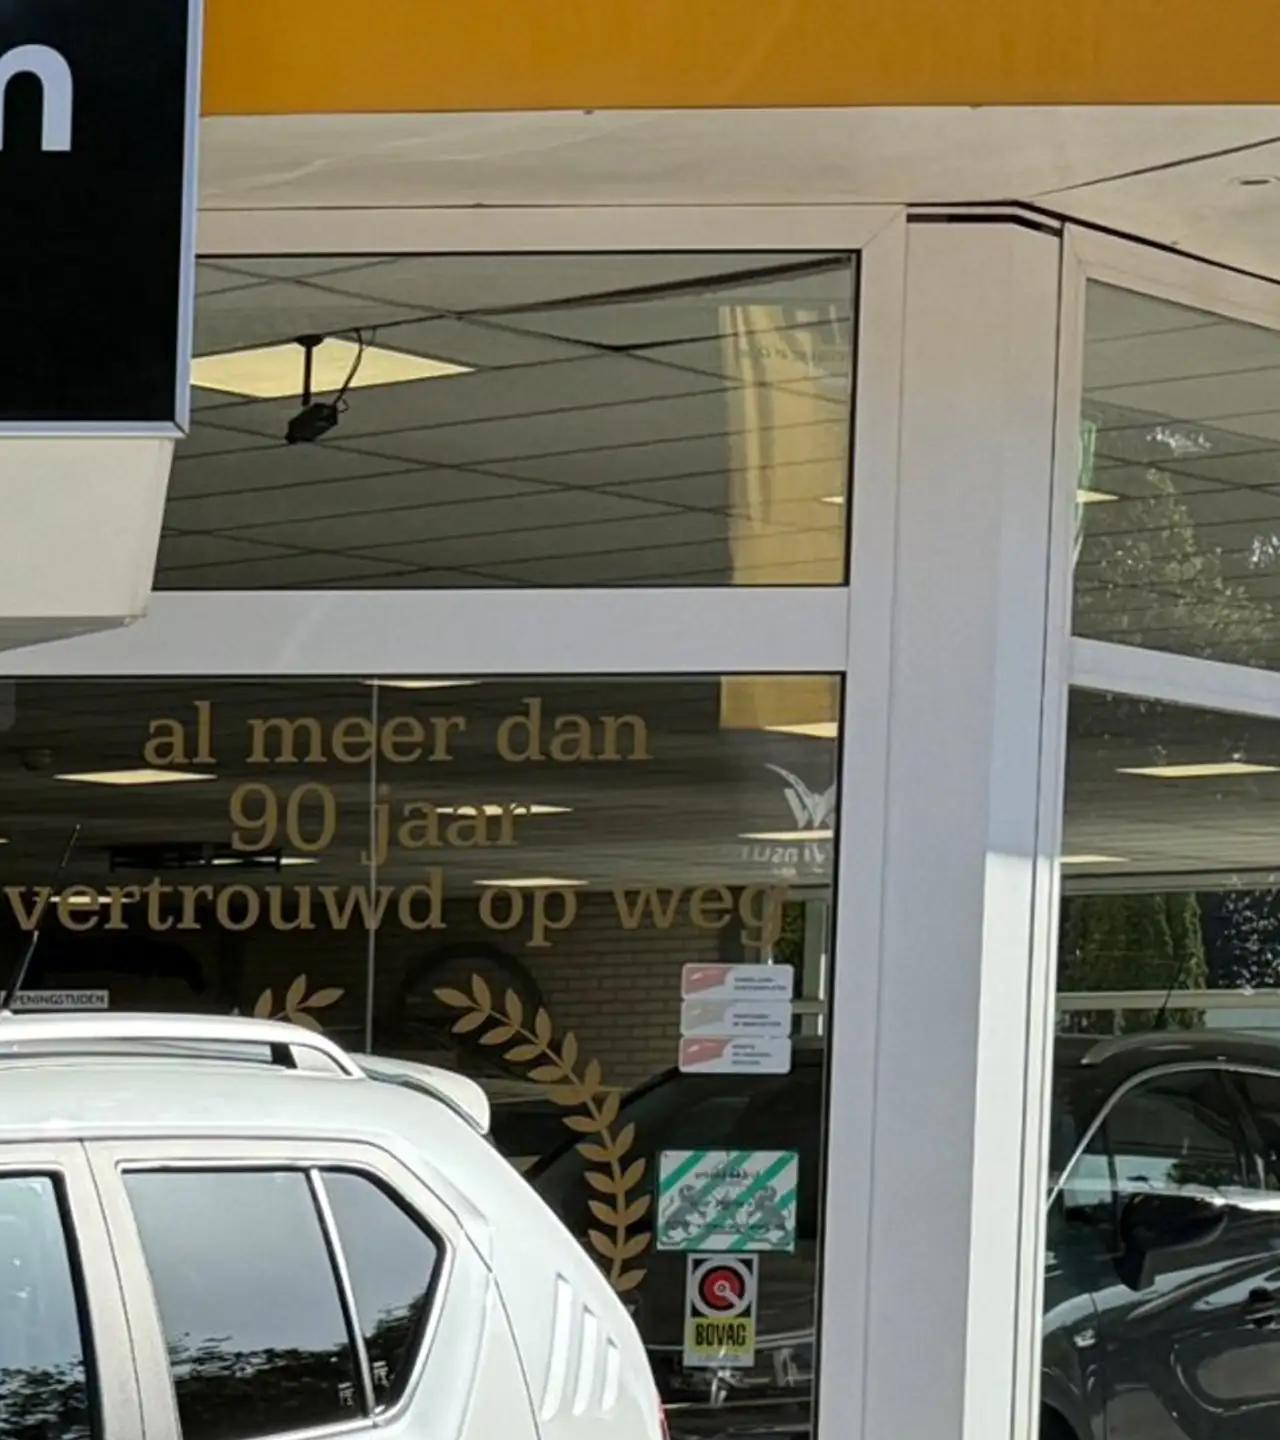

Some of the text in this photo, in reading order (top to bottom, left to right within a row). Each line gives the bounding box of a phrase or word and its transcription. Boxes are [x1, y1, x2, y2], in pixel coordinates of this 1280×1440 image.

[143, 697, 653, 764] al meer dan
[229, 782, 532, 865] 90 jaar
[4, 871, 790, 946] vertrouwd op weg
[695, 1323, 746, 1347] BOVAG
